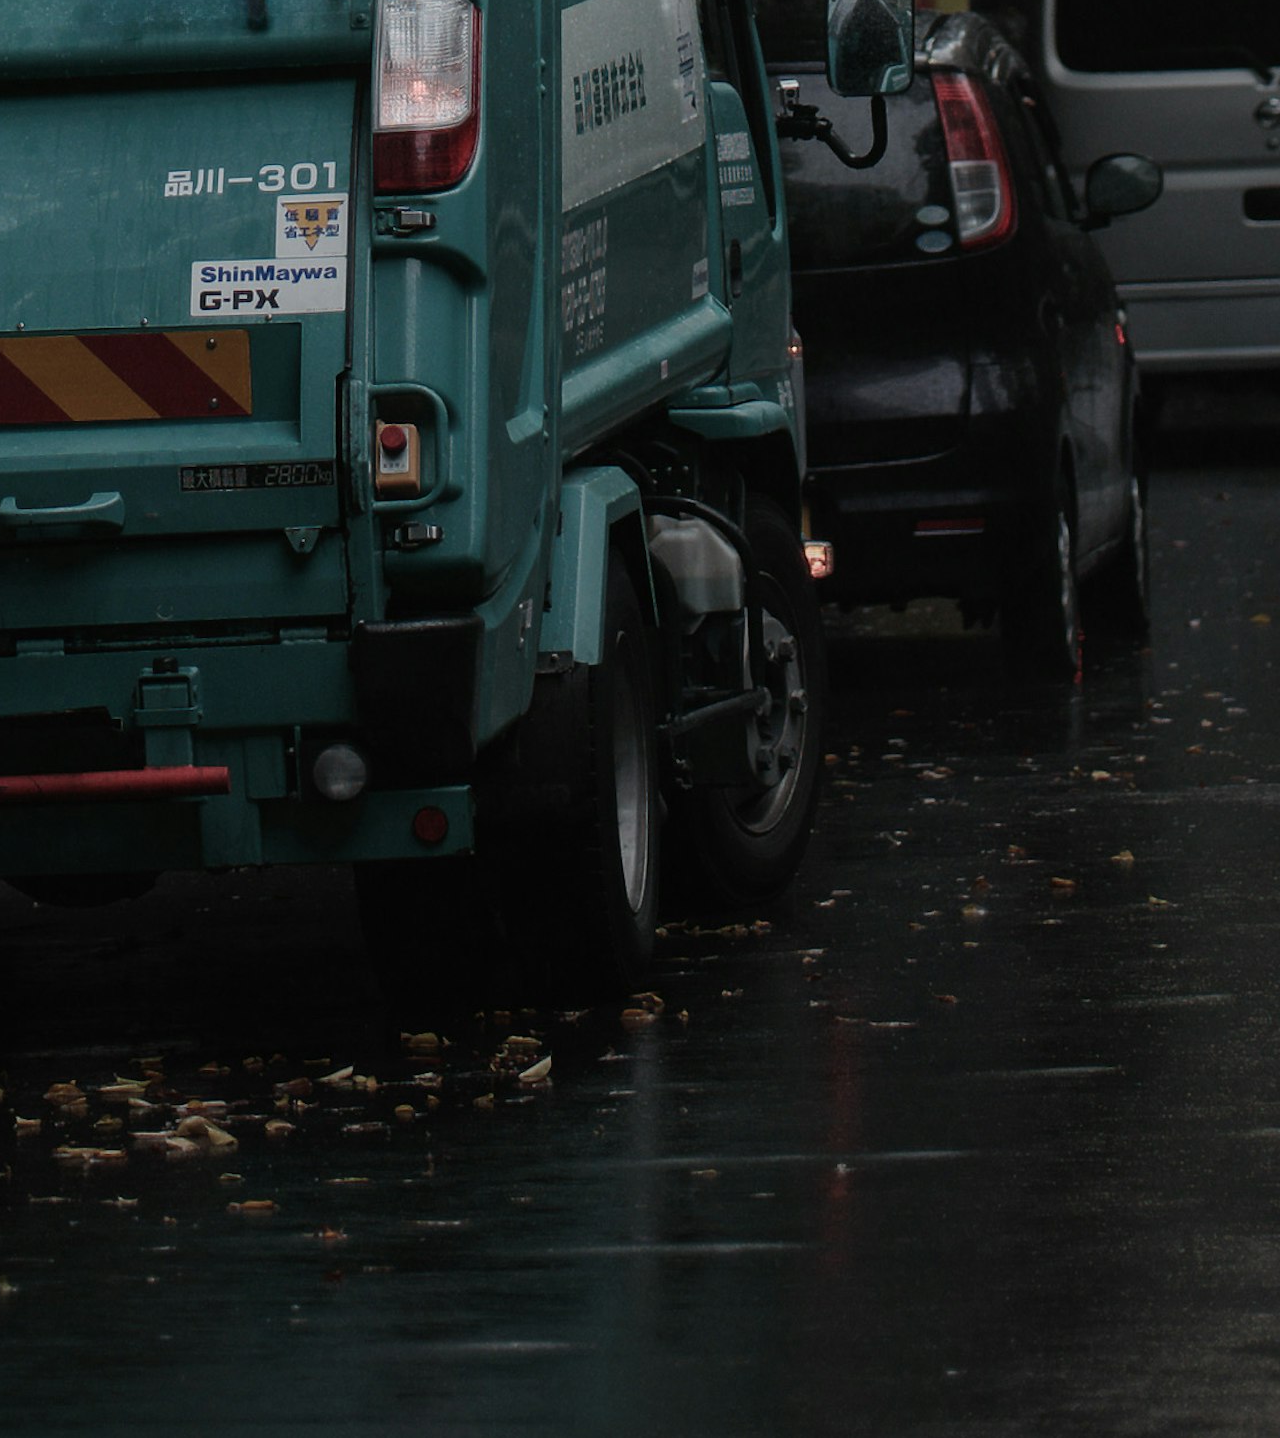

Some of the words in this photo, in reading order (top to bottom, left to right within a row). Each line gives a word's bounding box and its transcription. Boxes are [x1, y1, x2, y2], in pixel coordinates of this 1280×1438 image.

[284, 224, 340, 239] 省エネ型
[200, 265, 338, 284] ShinMaywa
[199, 289, 280, 311] G-PX
